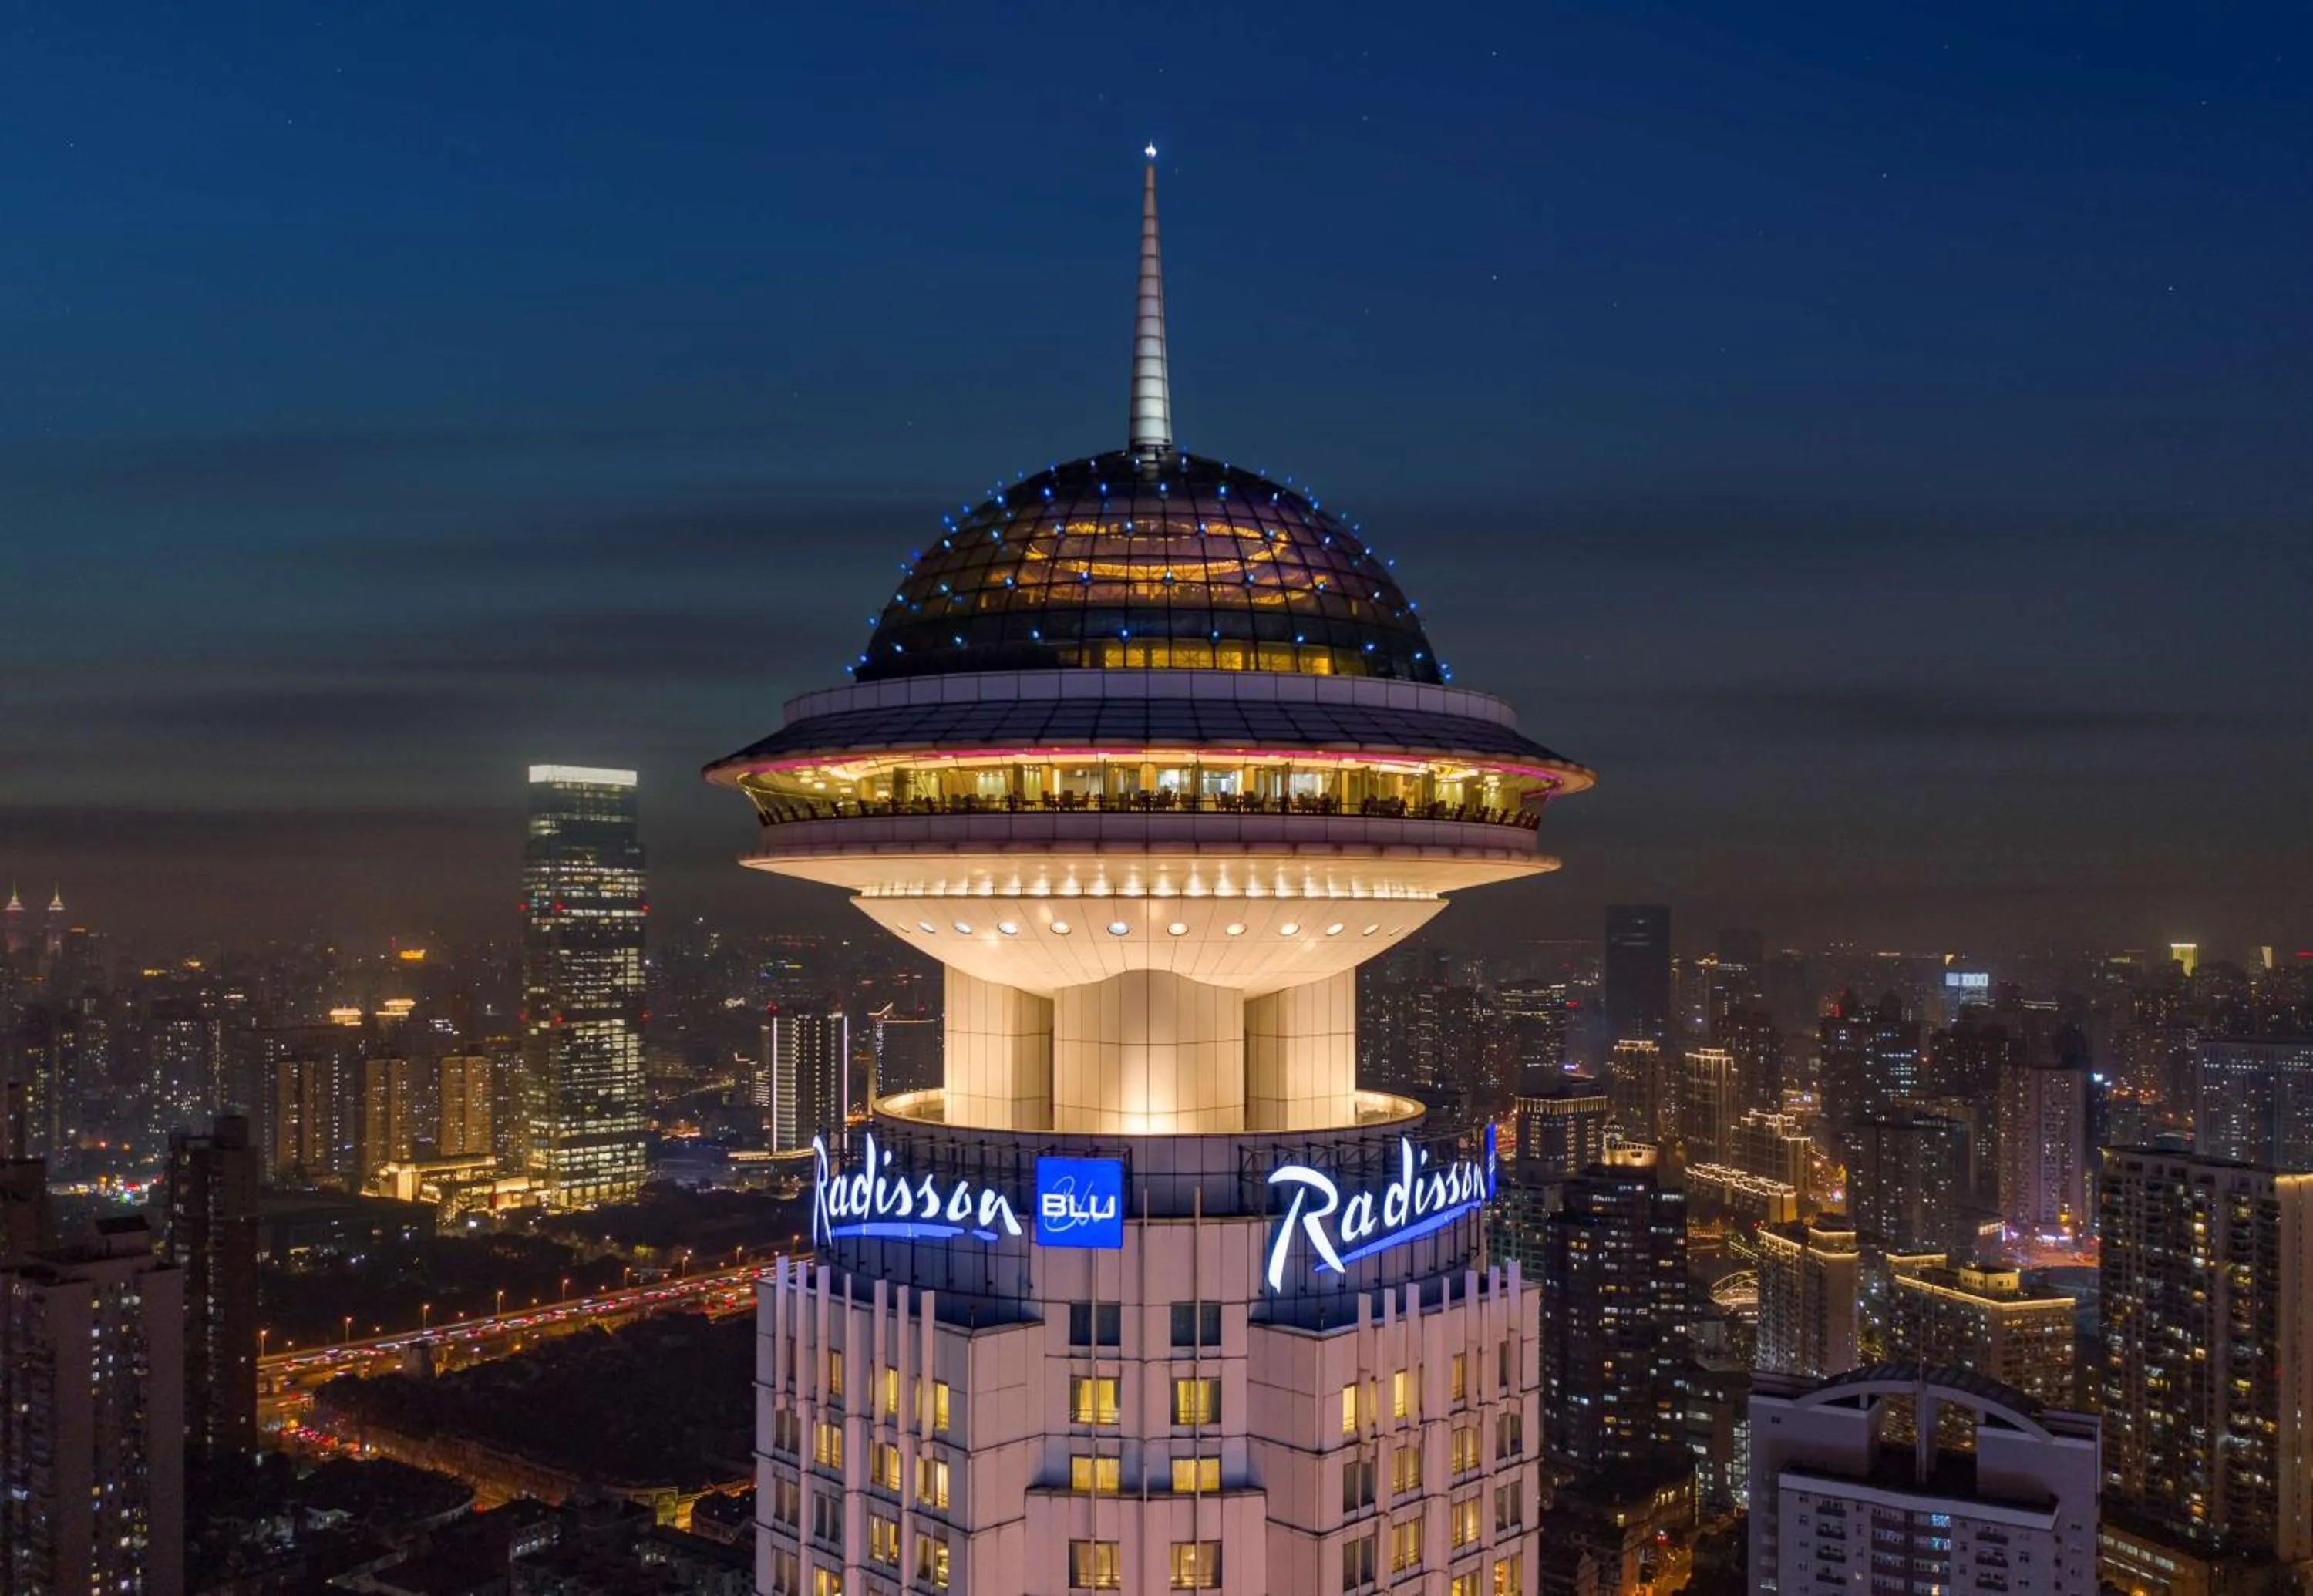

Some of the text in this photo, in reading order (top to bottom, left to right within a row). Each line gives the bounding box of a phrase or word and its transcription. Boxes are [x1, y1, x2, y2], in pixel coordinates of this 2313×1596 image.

[813, 1133, 1023, 1245] Radisson
[1042, 1193, 1116, 1219] BLU
[1268, 1137, 1486, 1294] Radisson
